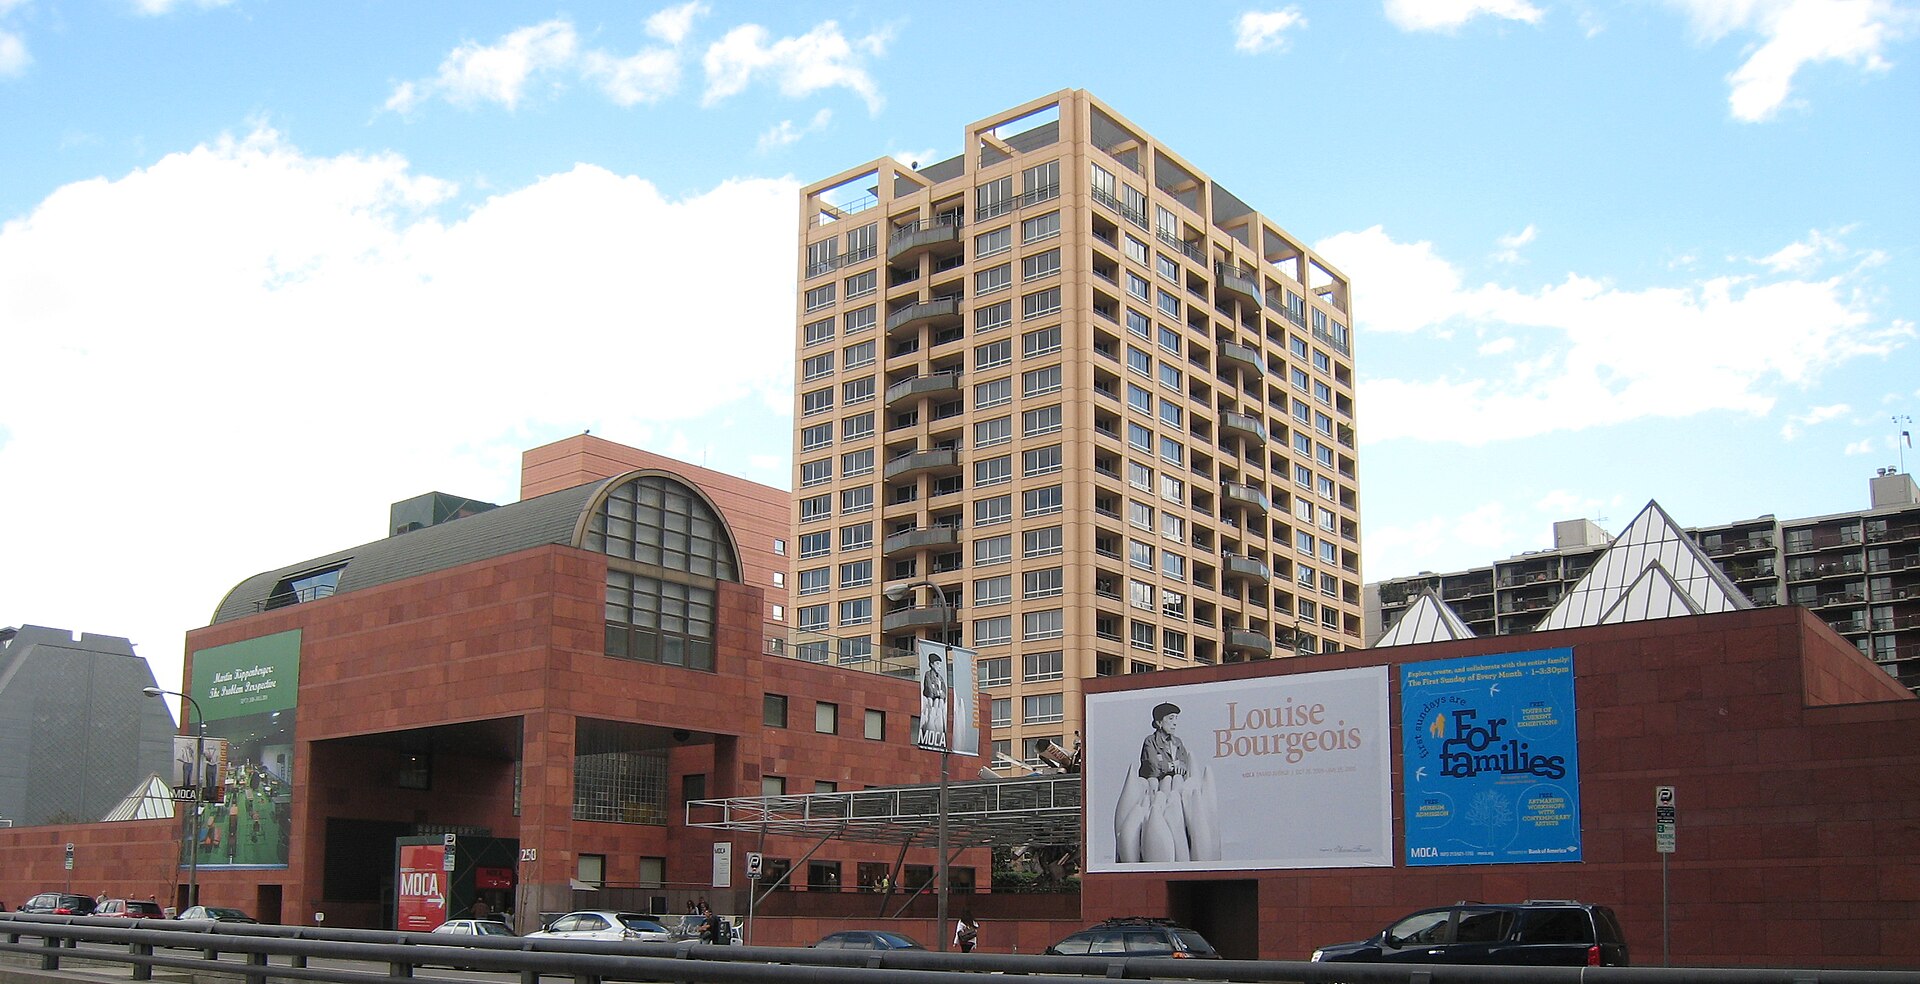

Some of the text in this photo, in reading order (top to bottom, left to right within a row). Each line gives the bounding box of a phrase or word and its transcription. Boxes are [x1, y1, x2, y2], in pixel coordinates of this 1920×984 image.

[1440, 675, 1465, 684] Sunday
[1498, 670, 1522, 678] Month
[208, 679, 276, 699] The Problem Perspective
[1226, 697, 1325, 731] Louise
[1416, 696, 1447, 732] sundays
[1449, 696, 1466, 706] are
[918, 730, 946, 747] MOCA
[1451, 708, 1507, 752] For
[1213, 720, 1361, 764] Bourgeois
[1439, 739, 1566, 779] families
[173, 789, 196, 799] MOCA
[521, 848, 537, 861] 250
[1410, 847, 1438, 858] MOCA
[401, 873, 438, 896] MOCA
